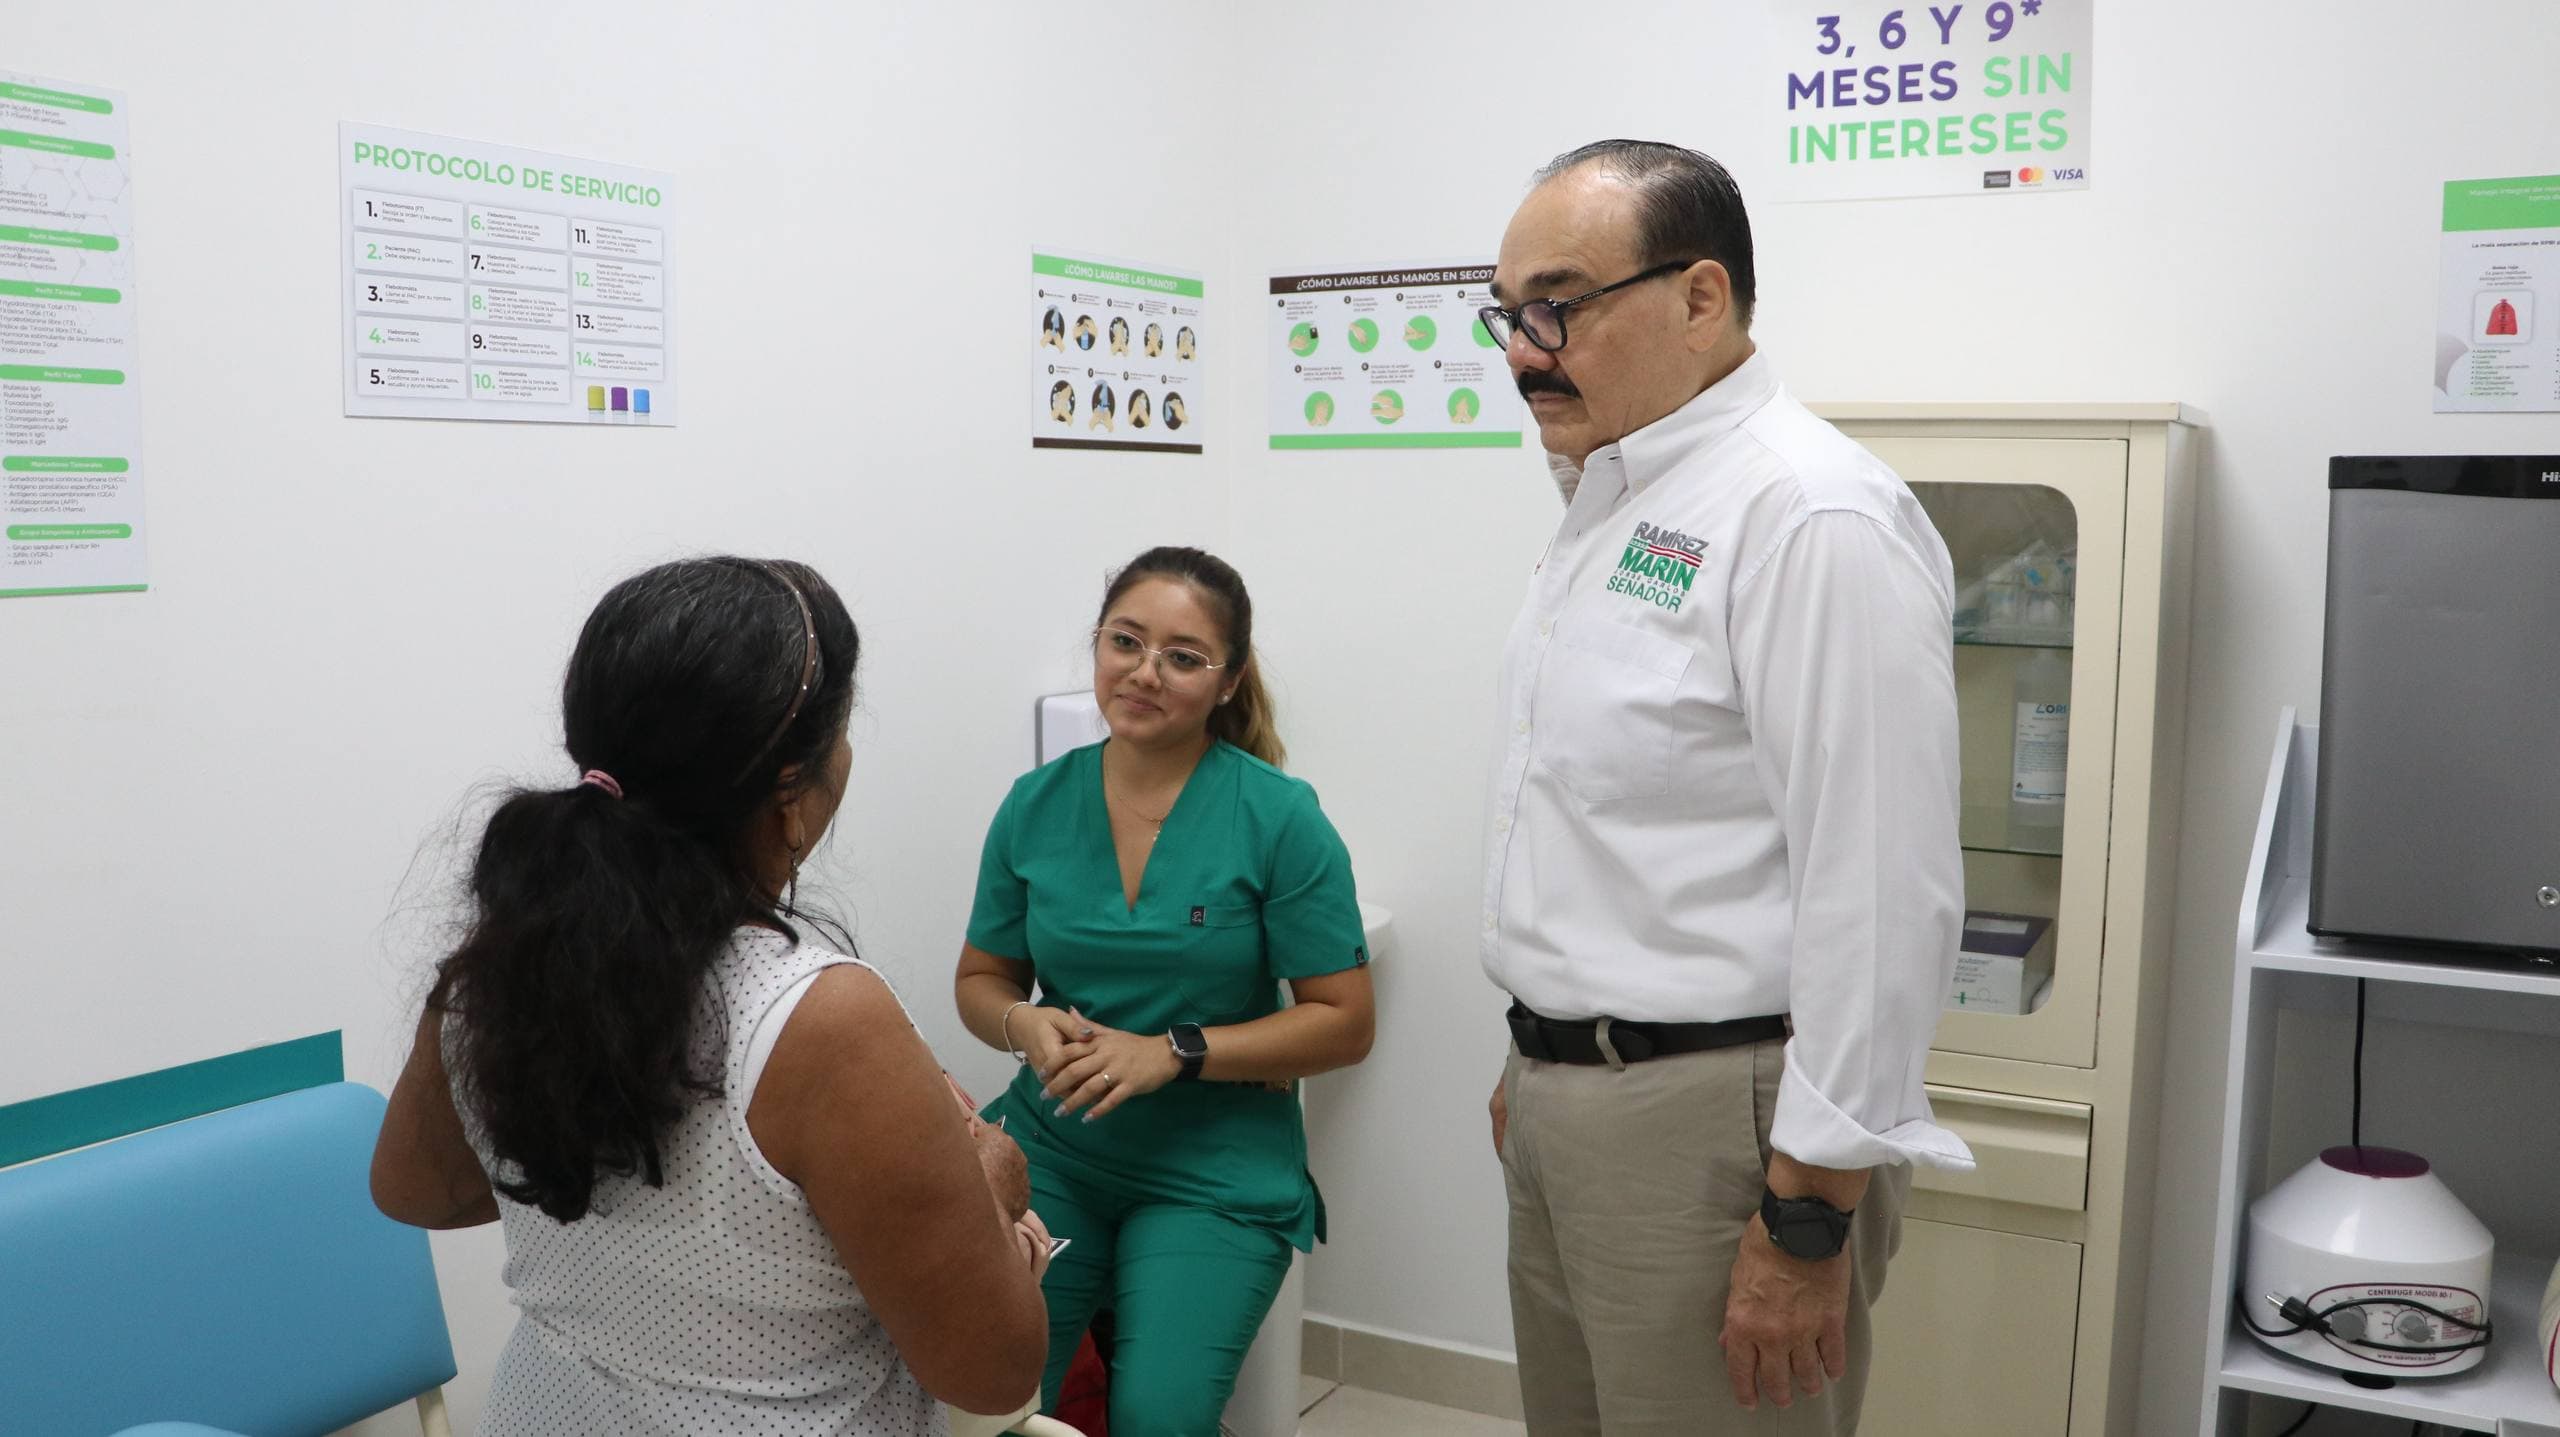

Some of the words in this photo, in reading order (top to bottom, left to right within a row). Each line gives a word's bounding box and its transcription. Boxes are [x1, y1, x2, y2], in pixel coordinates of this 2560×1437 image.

[1816, 15, 1855, 58] 3,
[1879, 10, 1907, 50] 6
[1928, 5, 1963, 45] Y
[1788, 61, 1958, 110] MESES
[1983, 52, 2071, 98] SIN
[1789, 108, 2069, 164] INTERESES
[354, 142, 515, 186] PROTOCOLO
[522, 168, 554, 192] DE
[560, 174, 662, 208] SERVICIO
[2052, 168, 2084, 180] VISA
[366, 201, 378, 218] 1.
[471, 215, 485, 230] 6.
[575, 228, 590, 244] 11.
[367, 244, 382, 260] 2.
[471, 255, 485, 270] 7.
[575, 272, 593, 288] 12.
[1094, 267, 1130, 283] LAVARSE
[1131, 274, 1146, 286] LAS
[1297, 278, 1332, 291] ¿CÓMO
[1334, 275, 1378, 287] LAVARSE
[1380, 274, 1400, 284] LAS
[1402, 272, 1441, 283] MANOS
[1443, 271, 1457, 280] EN
[1460, 269, 1493, 280] SECO?
[368, 286, 383, 302] 3.
[472, 295, 486, 310] 8.
[576, 314, 594, 330] 13.
[369, 328, 385, 344] 4.
[472, 334, 487, 350] 9.
[576, 351, 596, 367] 14.
[370, 369, 385, 385] 5.
[474, 374, 495, 390] 10.
[1633, 521, 1710, 559] RAMÍREZ
[1617, 547, 1697, 592] MARÍN
[1606, 576, 1682, 613] SENADOR
[2367, 1289, 2413, 1297] CENTRIFUGE
[2415, 1290, 2438, 1298] MODEL
